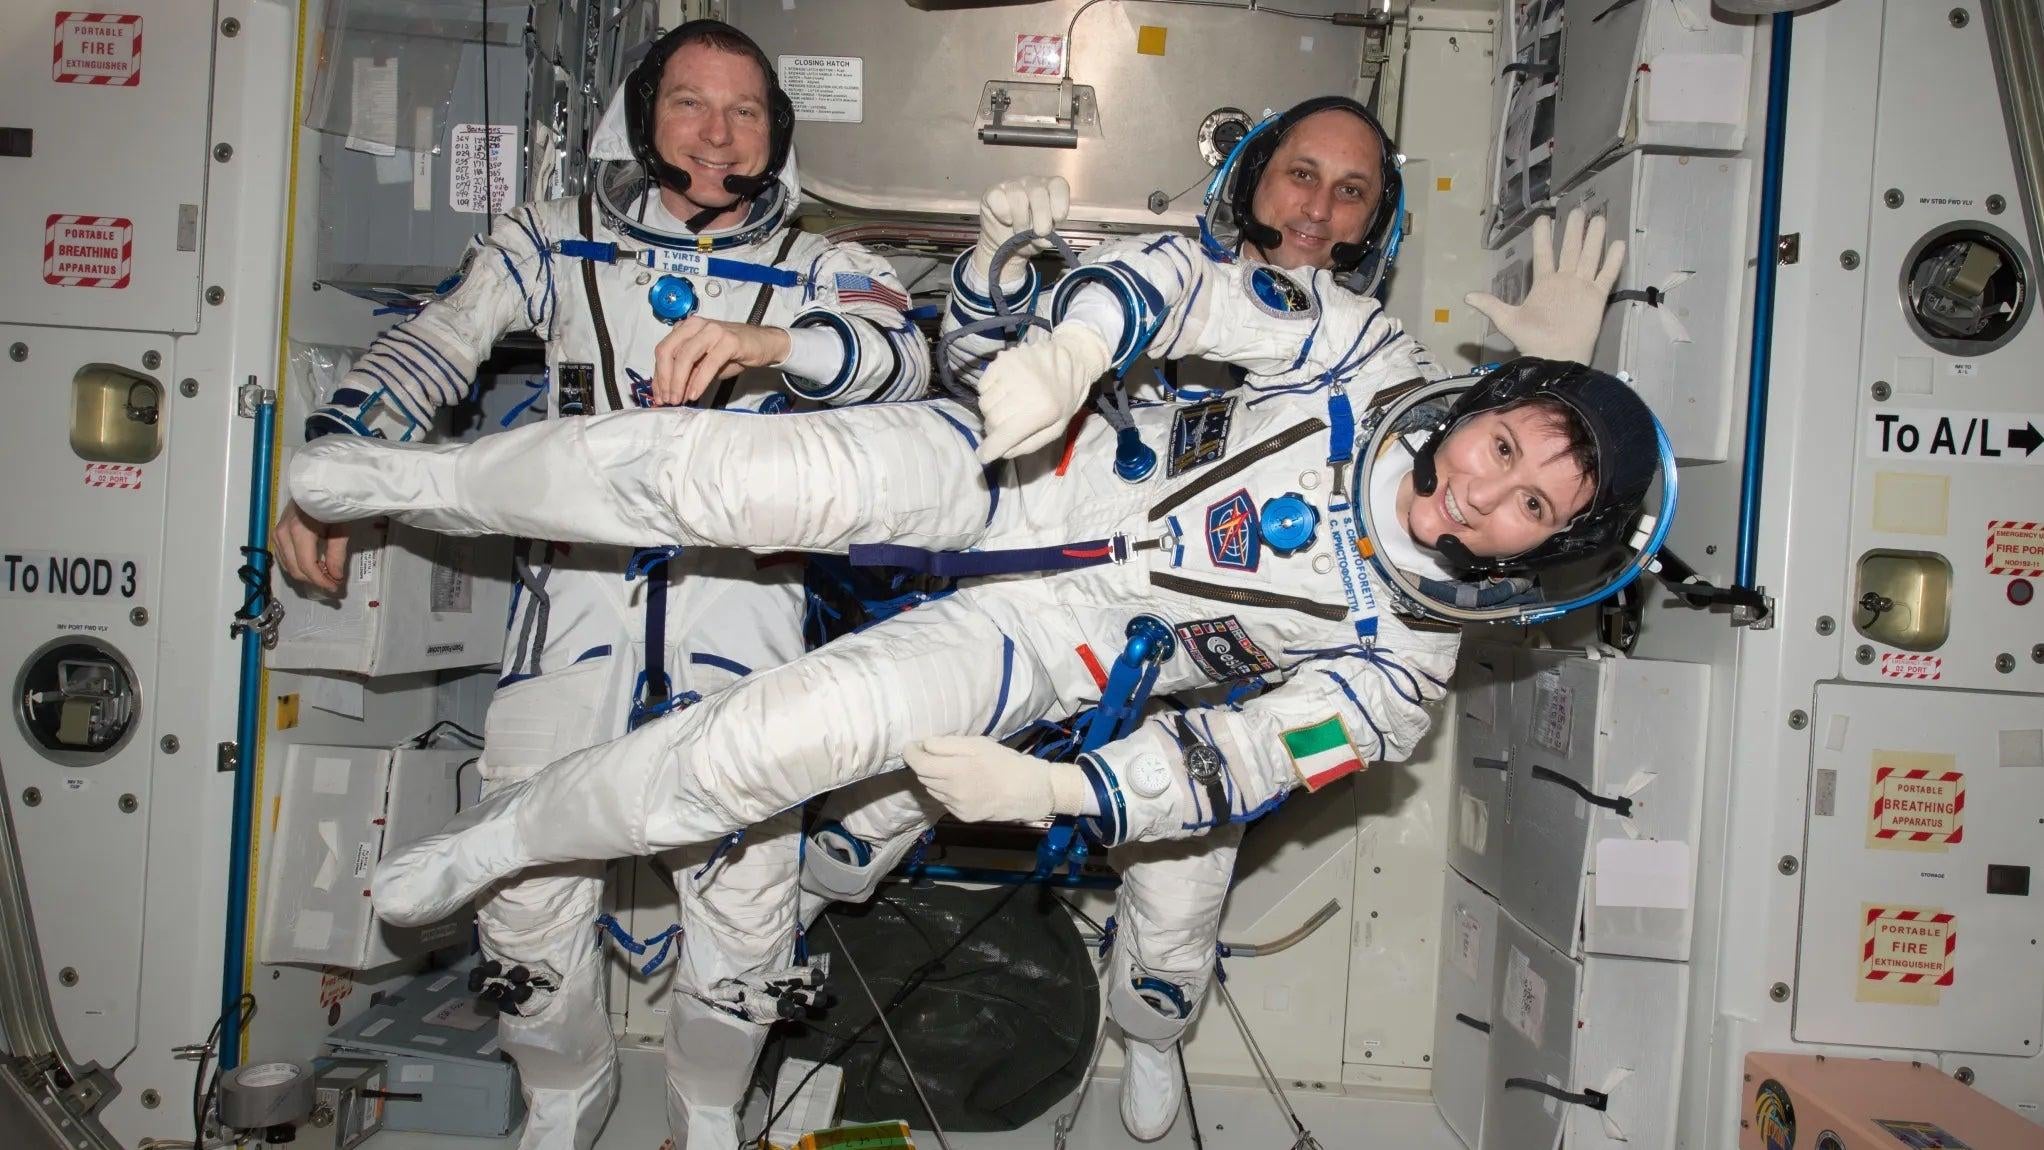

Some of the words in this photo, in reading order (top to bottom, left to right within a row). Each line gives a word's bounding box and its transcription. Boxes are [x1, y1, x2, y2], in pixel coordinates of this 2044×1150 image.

[74, 26, 123, 37] PORTABLE
[81, 41, 114, 55] FIRE
[66, 60, 127, 71] EXTINGUISHER
[65, 229, 114, 240] PORTABLE
[59, 245, 118, 258] BREATHING
[663, 250, 670, 259] T.
[672, 252, 701, 263] VIRTS
[58, 263, 117, 274] APPARATUS
[1875, 414, 1919, 453] To
[1930, 416, 2002, 457] A/L
[1343, 516, 1352, 527] S.
[1996, 530, 2038, 539] EMERGENCY
[1996, 544, 2020, 554] FIRE
[2022, 545, 2044, 555] POR
[1346, 528, 1376, 610] CRISTOFORETTI
[4, 554, 39, 593] To
[48, 556, 113, 596] NOD
[120, 560, 137, 598] 3
[1897, 783, 1943, 795] PORTABLE
[1884, 798, 1954, 815] BREATHING
[1892, 816, 1943, 828] APPARATUS
[1881, 924, 1941, 937] PORTABLE
[1892, 941, 1928, 955] FIRE
[1874, 957, 1943, 970] EXTINGUISHER
